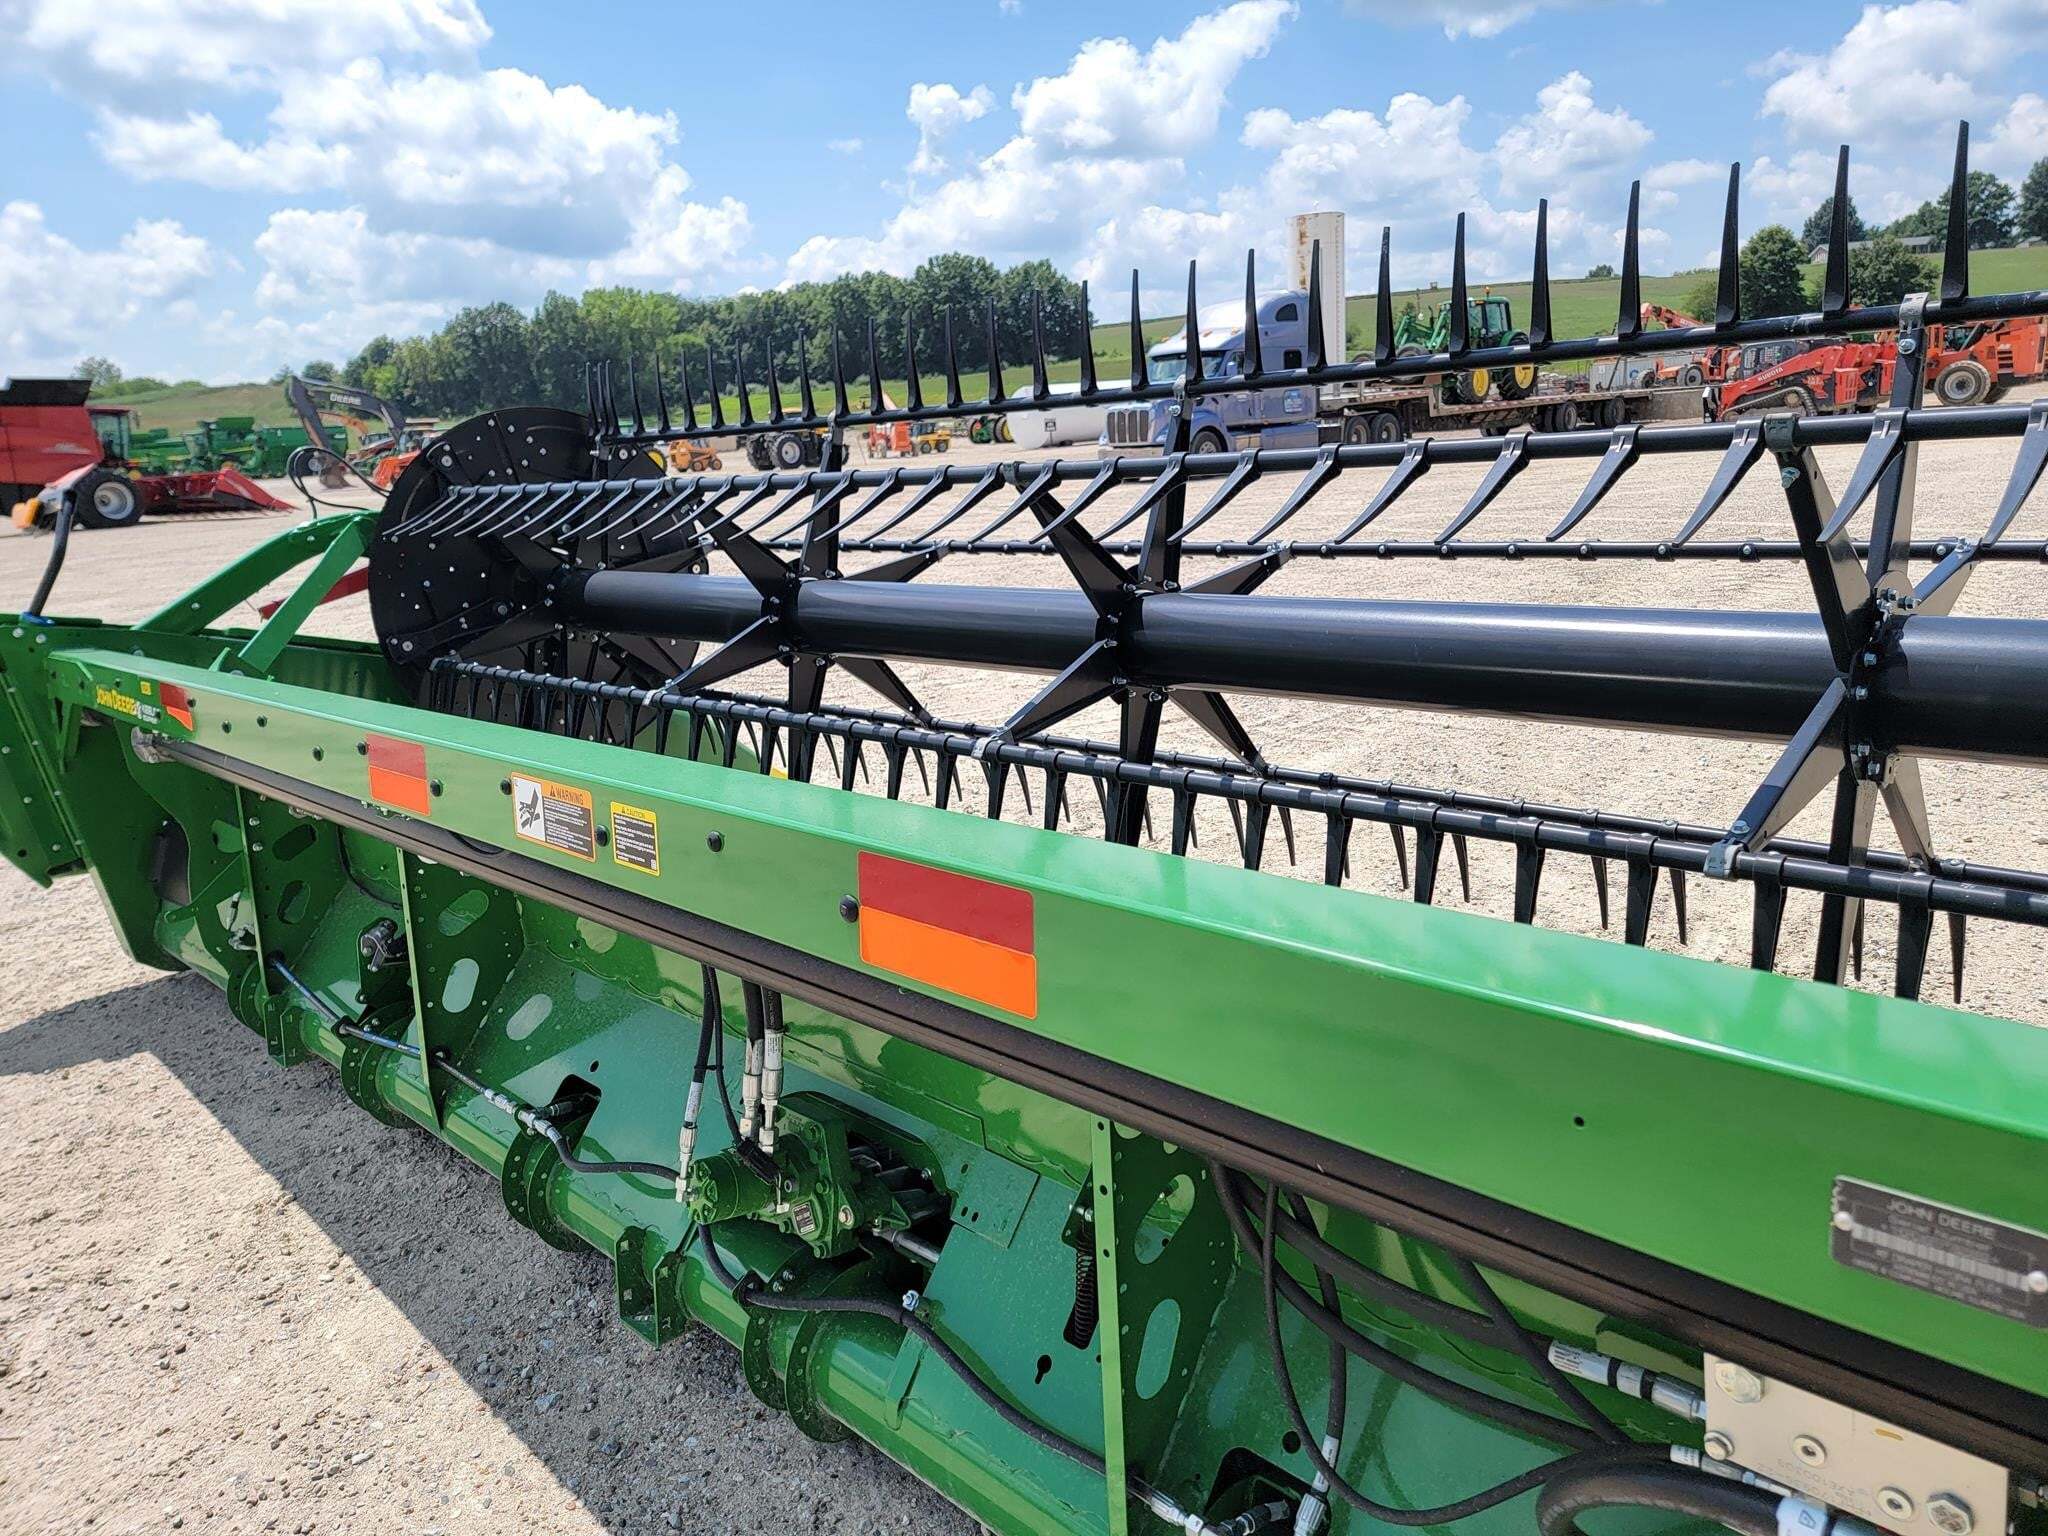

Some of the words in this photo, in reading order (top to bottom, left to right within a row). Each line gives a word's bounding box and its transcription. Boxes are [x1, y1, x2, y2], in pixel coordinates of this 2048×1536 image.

[556, 786, 584, 805] WARNING
[1887, 1200, 1933, 1222] JOHN
[1938, 1212, 1996, 1239] DEERE
